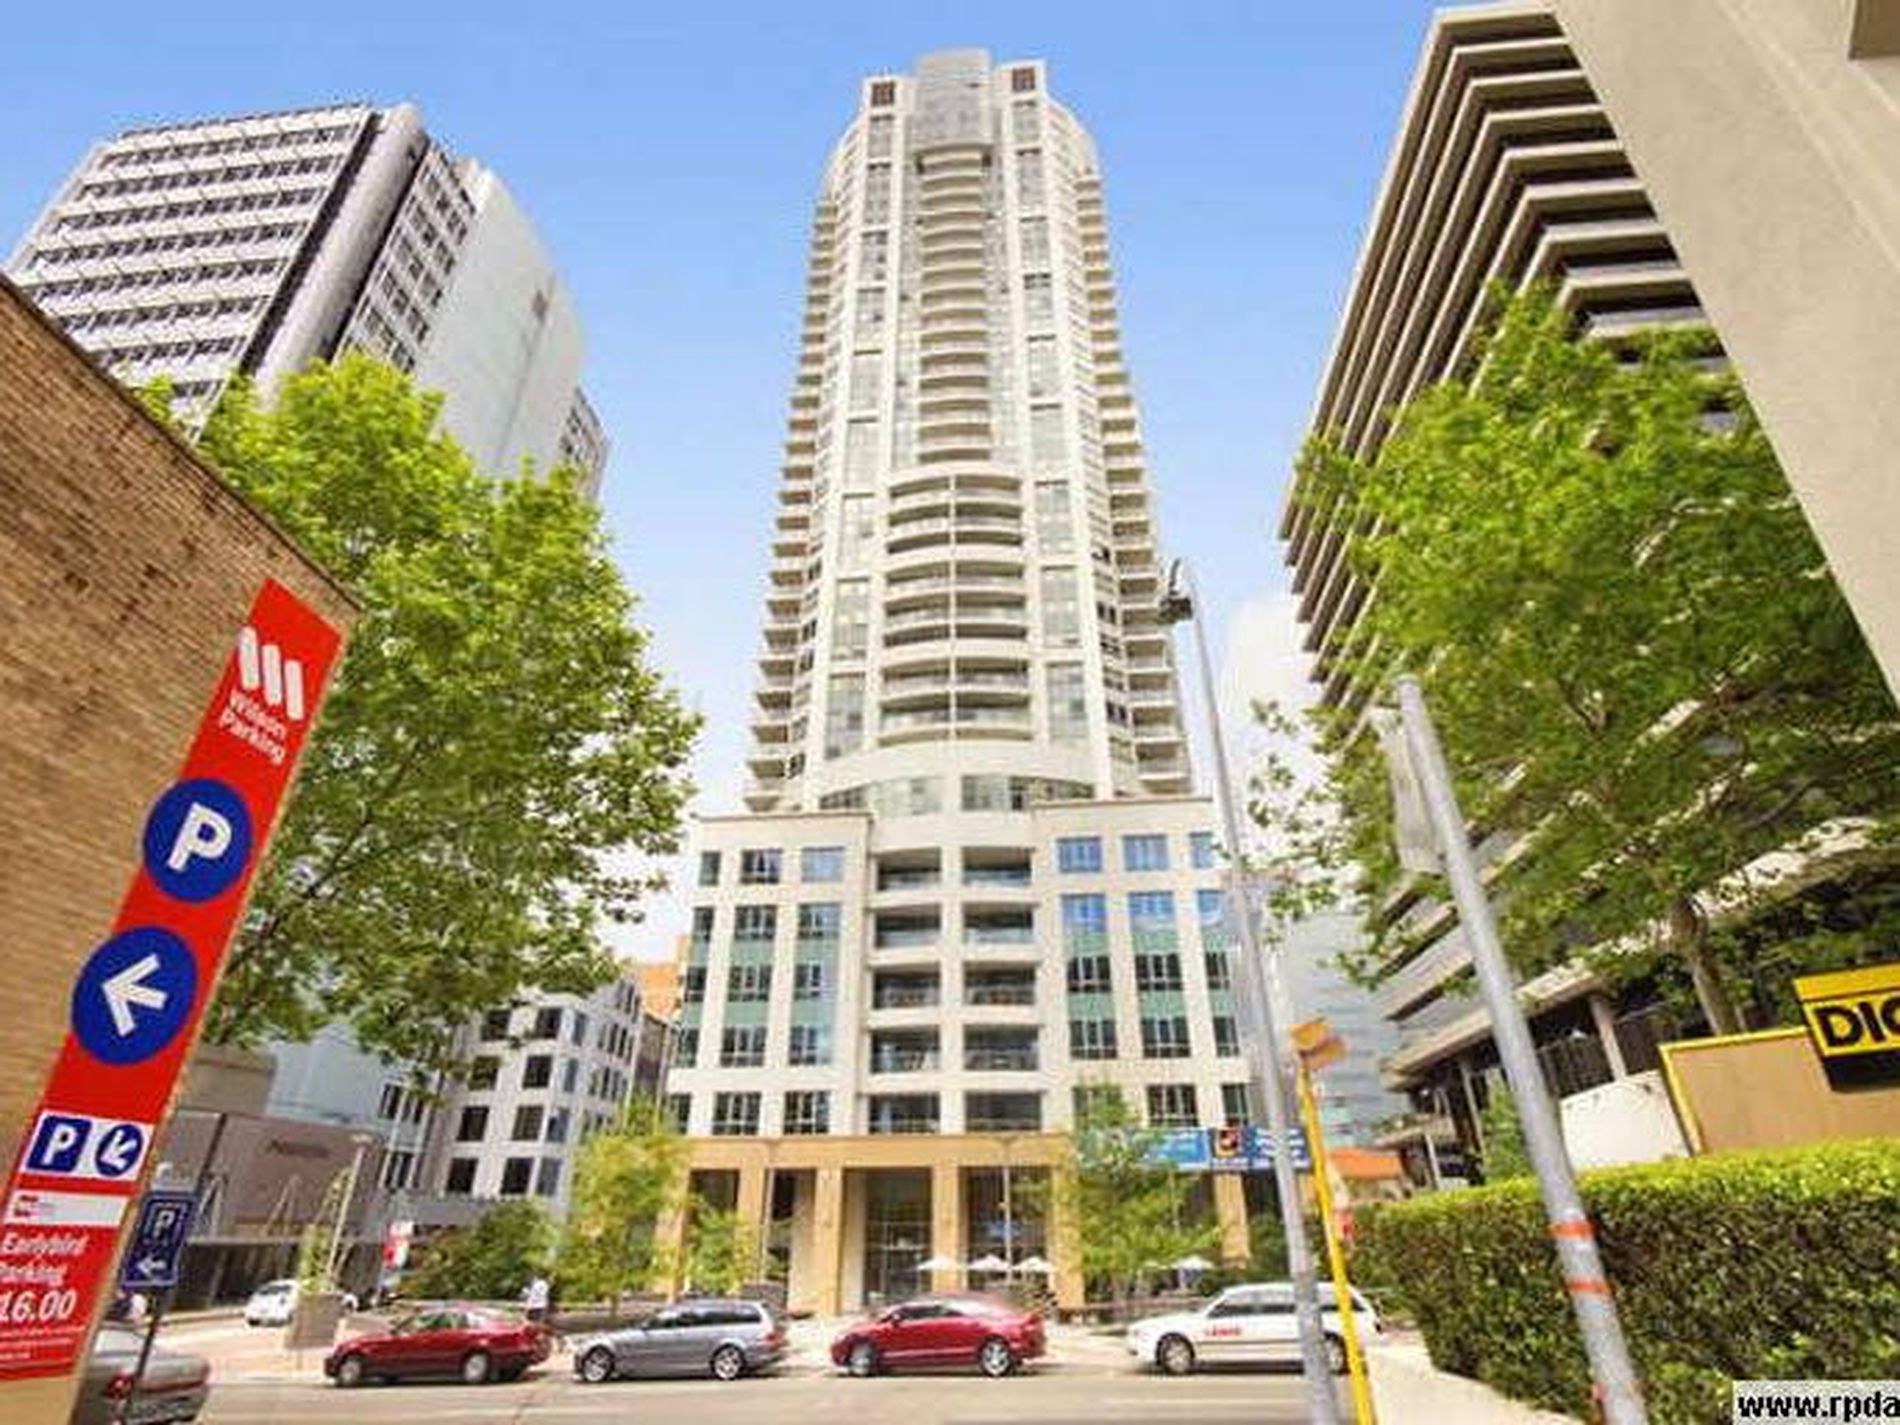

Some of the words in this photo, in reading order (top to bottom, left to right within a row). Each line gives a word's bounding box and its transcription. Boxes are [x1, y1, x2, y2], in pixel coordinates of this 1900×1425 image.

[218, 706, 286, 766] Parking
[229, 685, 288, 742] Wilson
[167, 801, 232, 872] P
[42, 1123, 78, 1166] P
[152, 1208, 176, 1238] P
